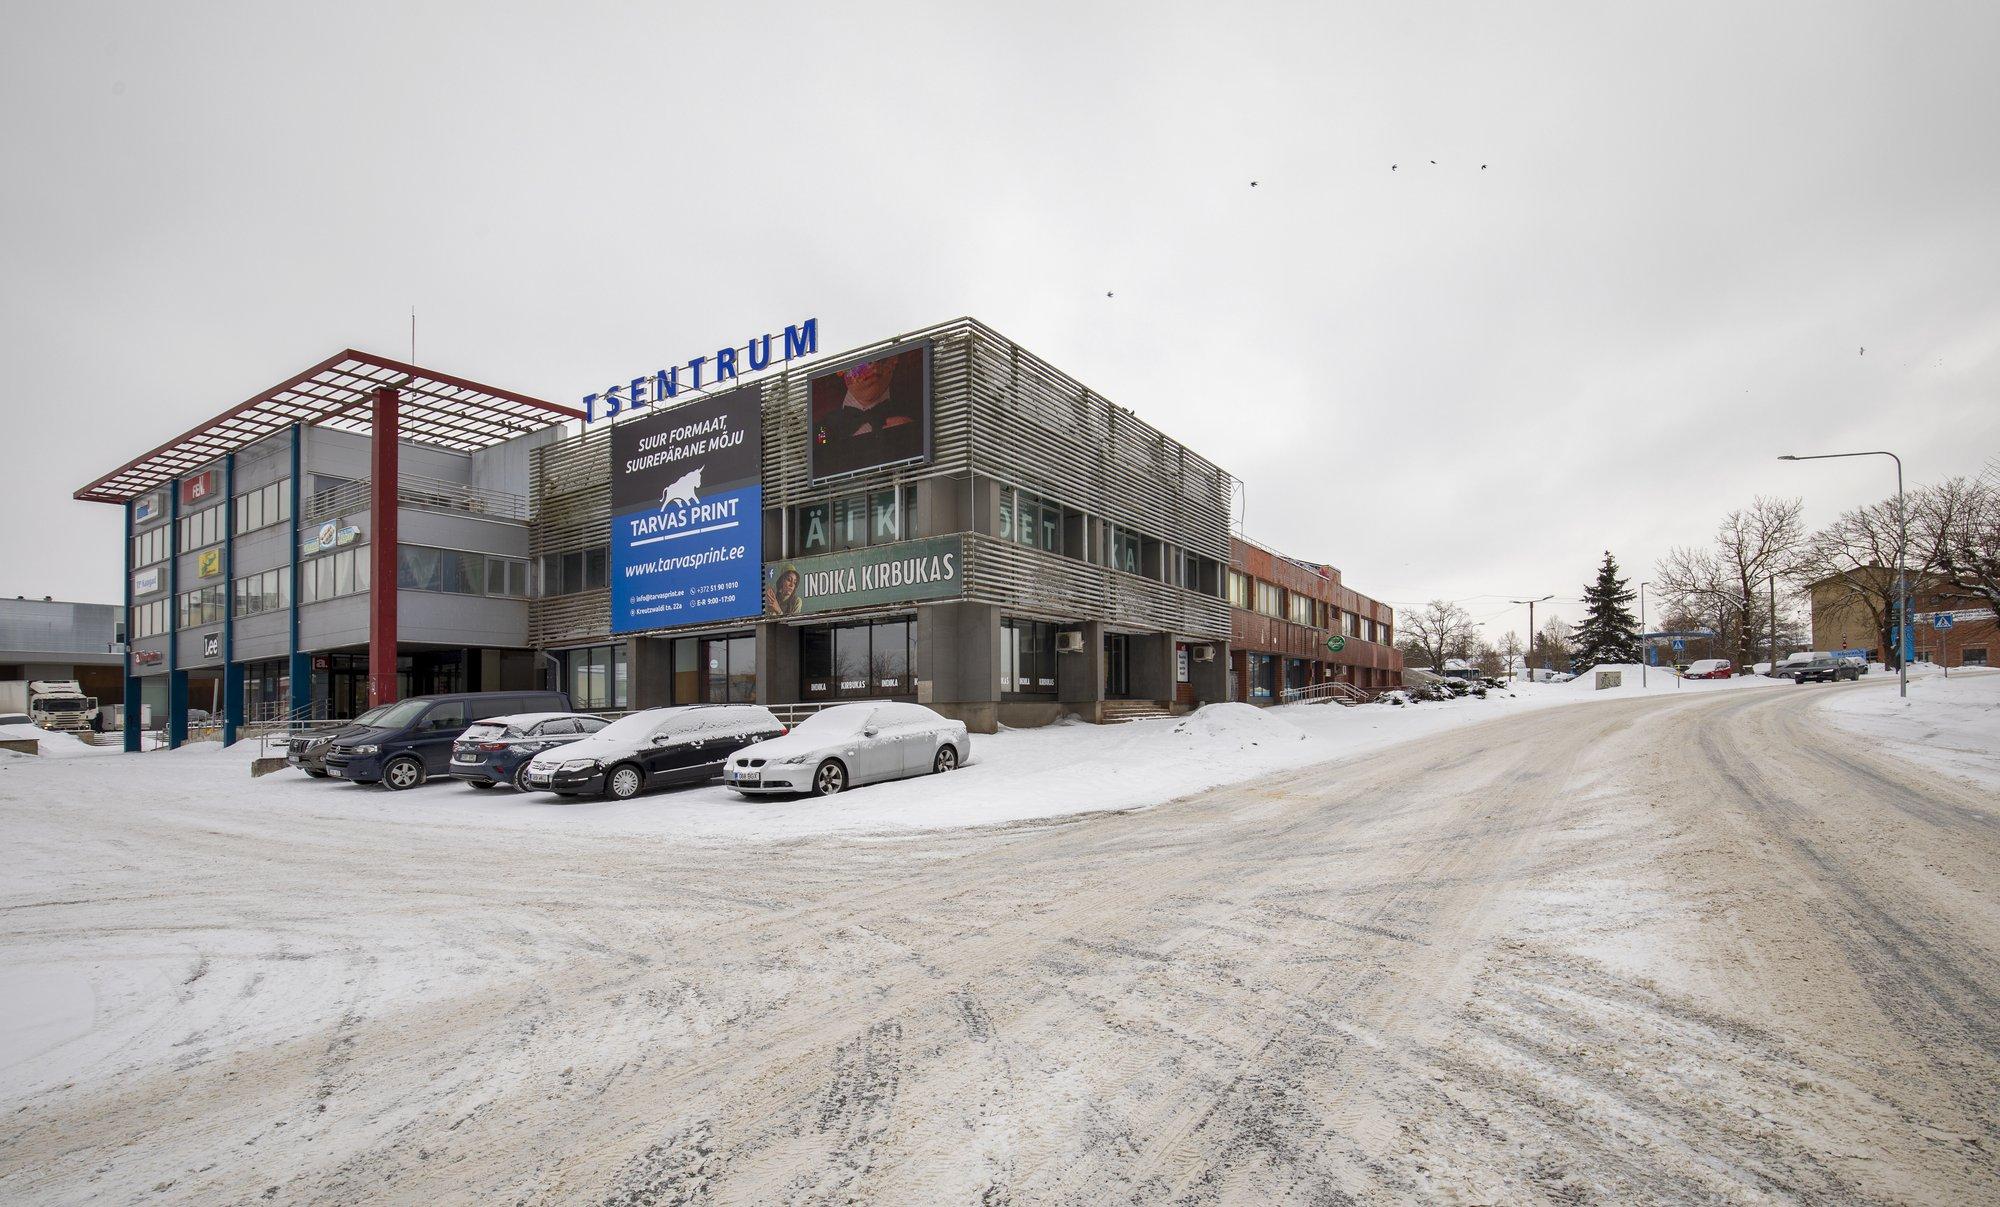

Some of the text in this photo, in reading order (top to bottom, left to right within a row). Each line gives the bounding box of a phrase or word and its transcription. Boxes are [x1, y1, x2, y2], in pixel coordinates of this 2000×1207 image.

[583, 318, 818, 424] TSENTRUM
[638, 415, 728, 452] SUUR FORMAAT,
[625, 429, 745, 474] SUUREPÄRANE MÕJU
[630, 498, 739, 537] TARVAS PRINT
[625, 545, 745, 578] www.tarvasprint.ee
[804, 553, 954, 598] INDIKA KIRBUKAS
[636, 590, 685, 602] info@tarvasprint.ee
[697, 585, 709, 594] +372
[710, 584, 716, 592] 51
[725, 581, 739, 590] 1010
[636, 605, 665, 615] Kreutzwaldi
[673, 602, 683, 610] 22a
[204, 638, 218, 656] Lee
